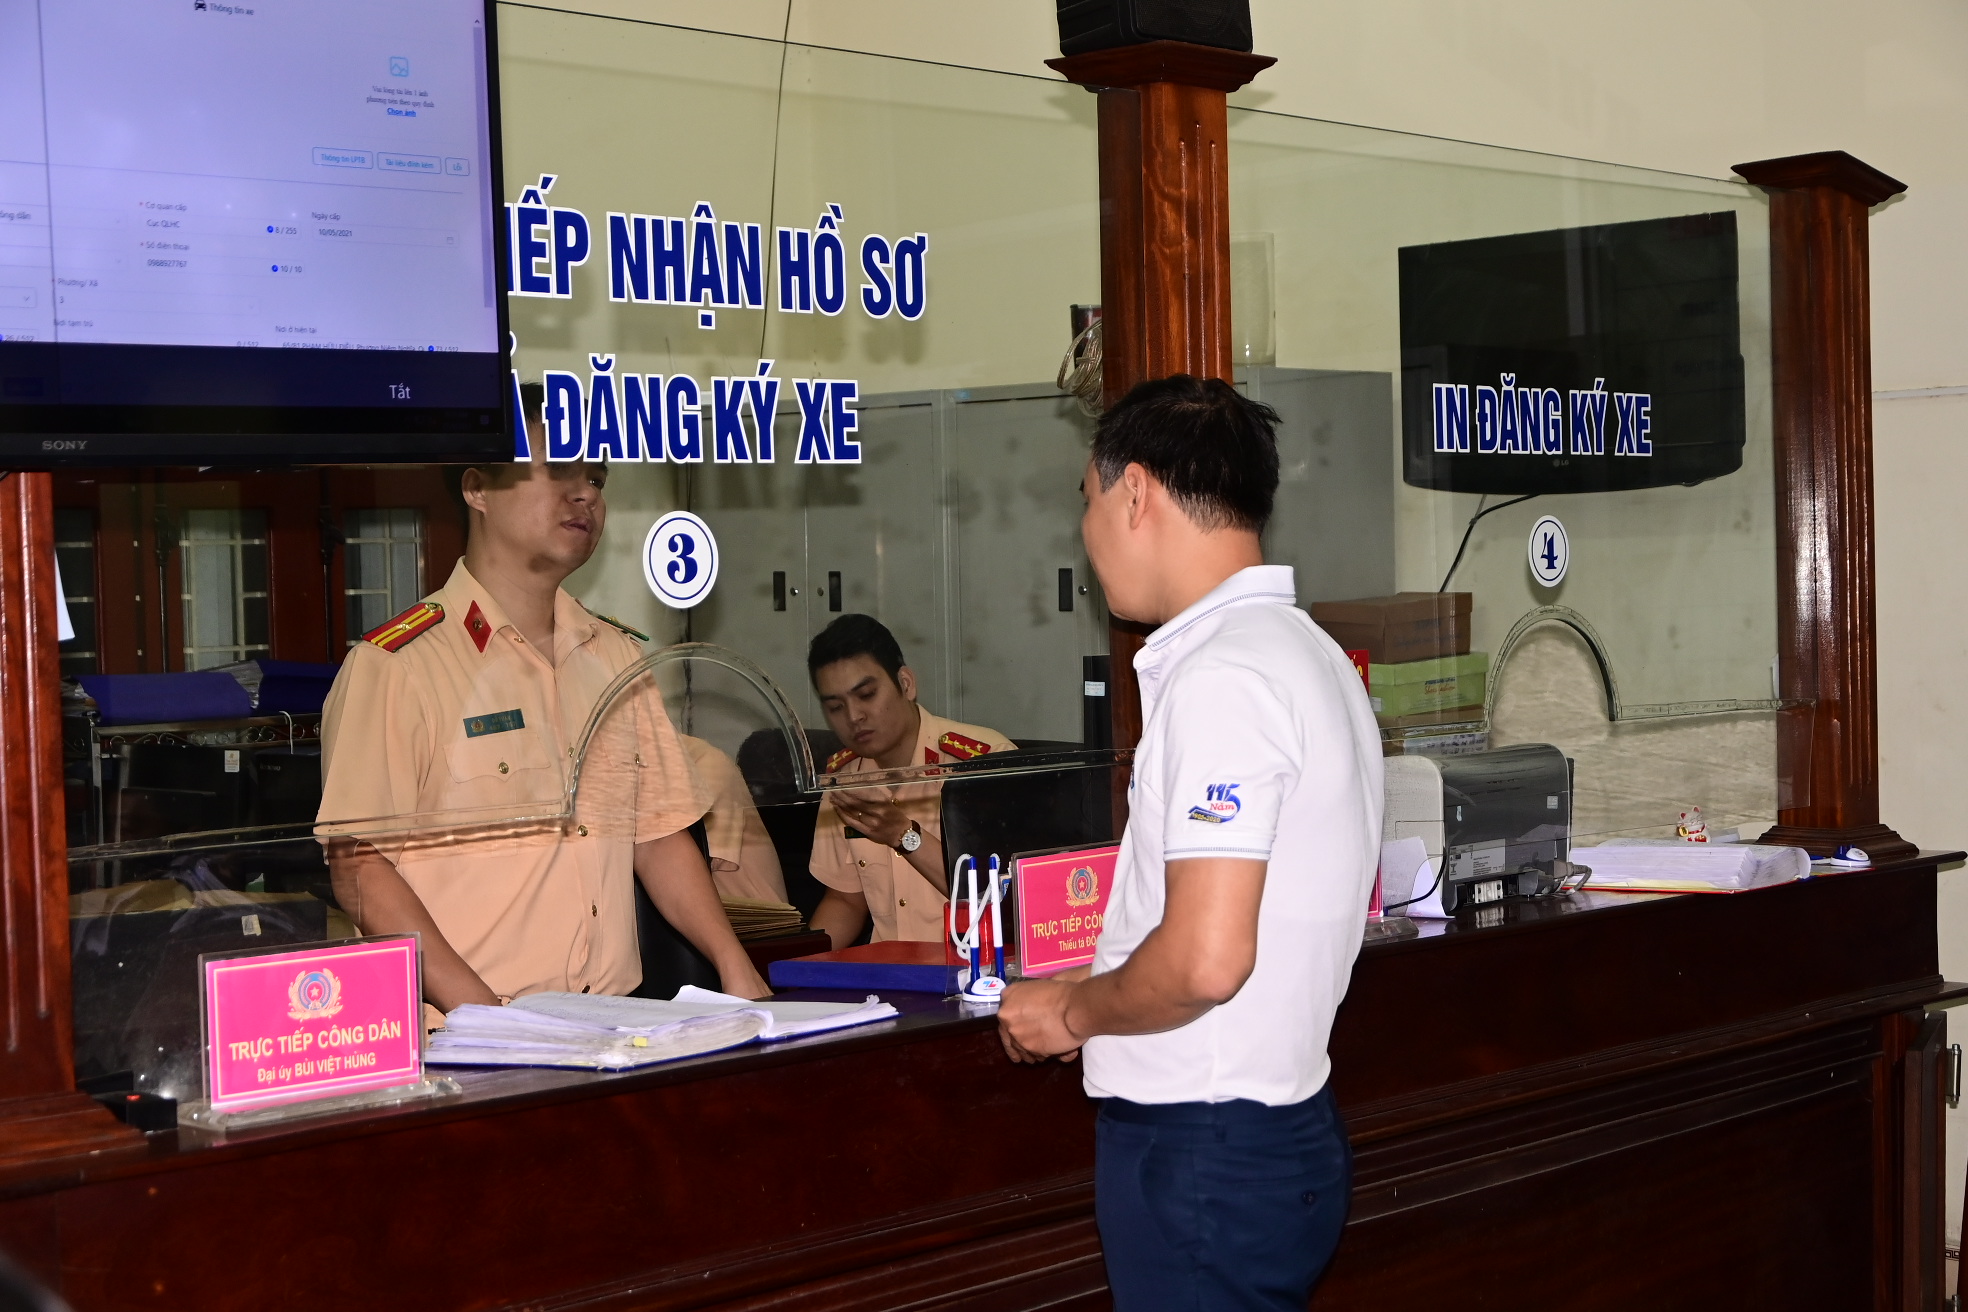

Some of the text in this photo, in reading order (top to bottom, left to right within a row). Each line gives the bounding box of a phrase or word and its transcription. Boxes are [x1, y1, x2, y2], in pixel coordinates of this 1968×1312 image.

[321, 153, 340, 165] Thông
[0, 210, 15, 220] ông
[312, 211, 341, 221] Ngày cấp
[286, 227, 297, 235] 255
[319, 228, 352, 237] 10/05/2021
[504, 173, 928, 330] IẾP NHẬN HỒ SƠ
[294, 265, 302, 273] 10
[389, 383, 411, 399] Tắt
[542, 353, 703, 463] ĐĂNG
[711, 359, 781, 463] KÝ
[792, 378, 862, 463] XE
[1432, 373, 1652, 456] IN ĐĂNG KÝ XE
[42, 440, 88, 450] SONY
[666, 532, 698, 584] 3
[1540, 532, 1558, 570] 4
[1206, 783, 1241, 814] 115
[1031, 911, 1104, 940] TRỰC TIẾP CÔN
[1059, 931, 1097, 951] Thiếu tá ĐỖ
[229, 1018, 401, 1062] TRỰC TIẾP CÔNG DÂN
[257, 1066, 275, 1086] Đại
[279, 1065, 292, 1081] úy
[316, 1055, 341, 1075] VIỆT
